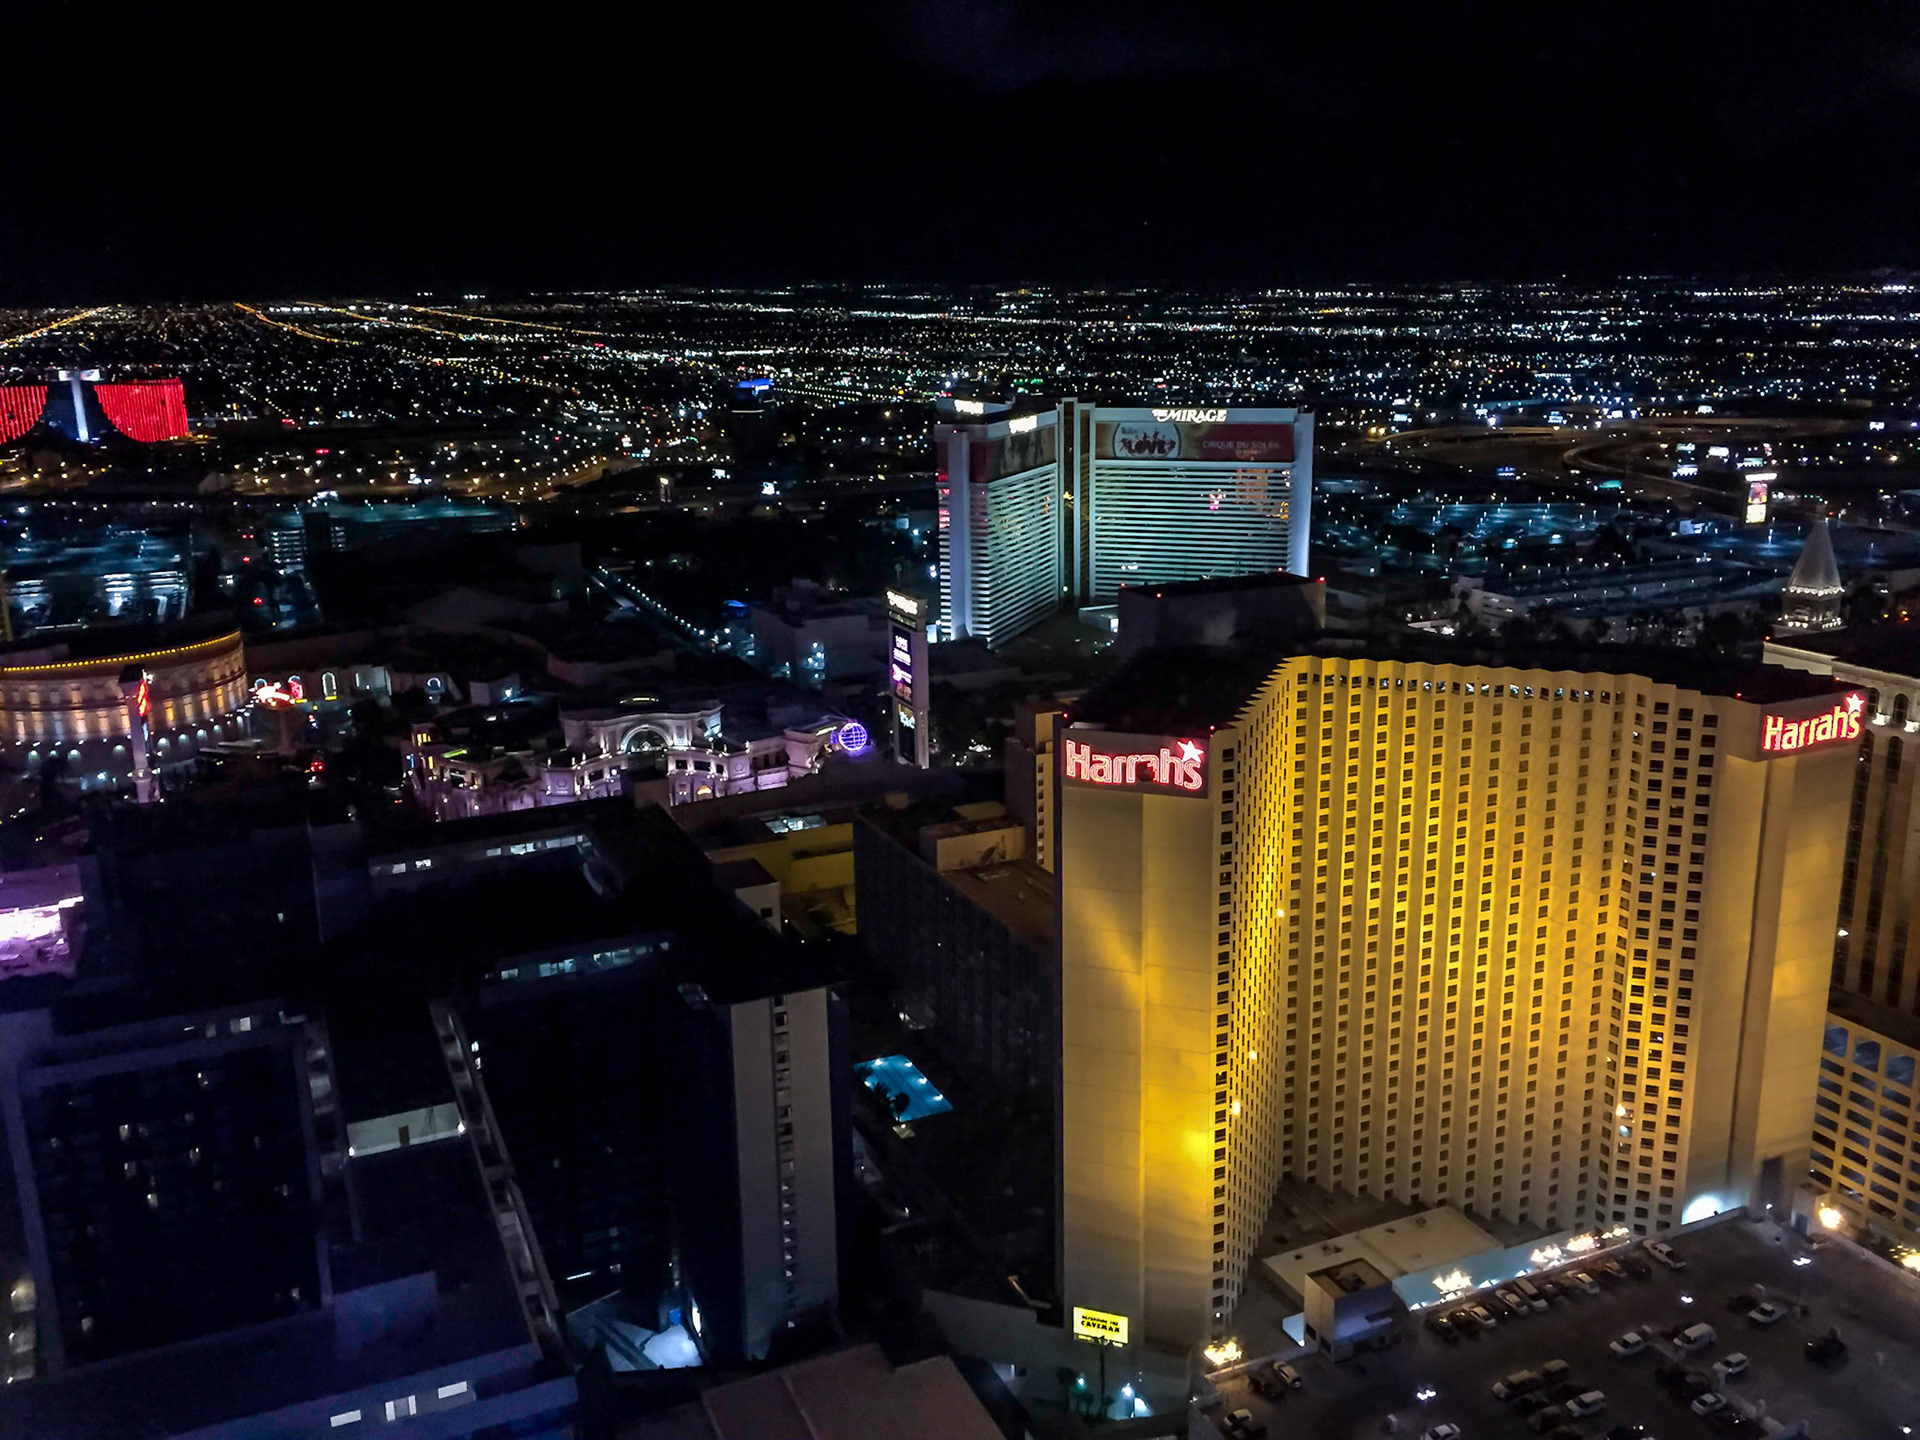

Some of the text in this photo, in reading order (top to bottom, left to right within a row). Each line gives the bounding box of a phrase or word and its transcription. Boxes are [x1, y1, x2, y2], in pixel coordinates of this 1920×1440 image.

[1156, 409, 1227, 424] MIRAGE
[1201, 440, 1235, 450] CIRQUE
[1081, 1320, 1120, 1333] CAVEMAN
